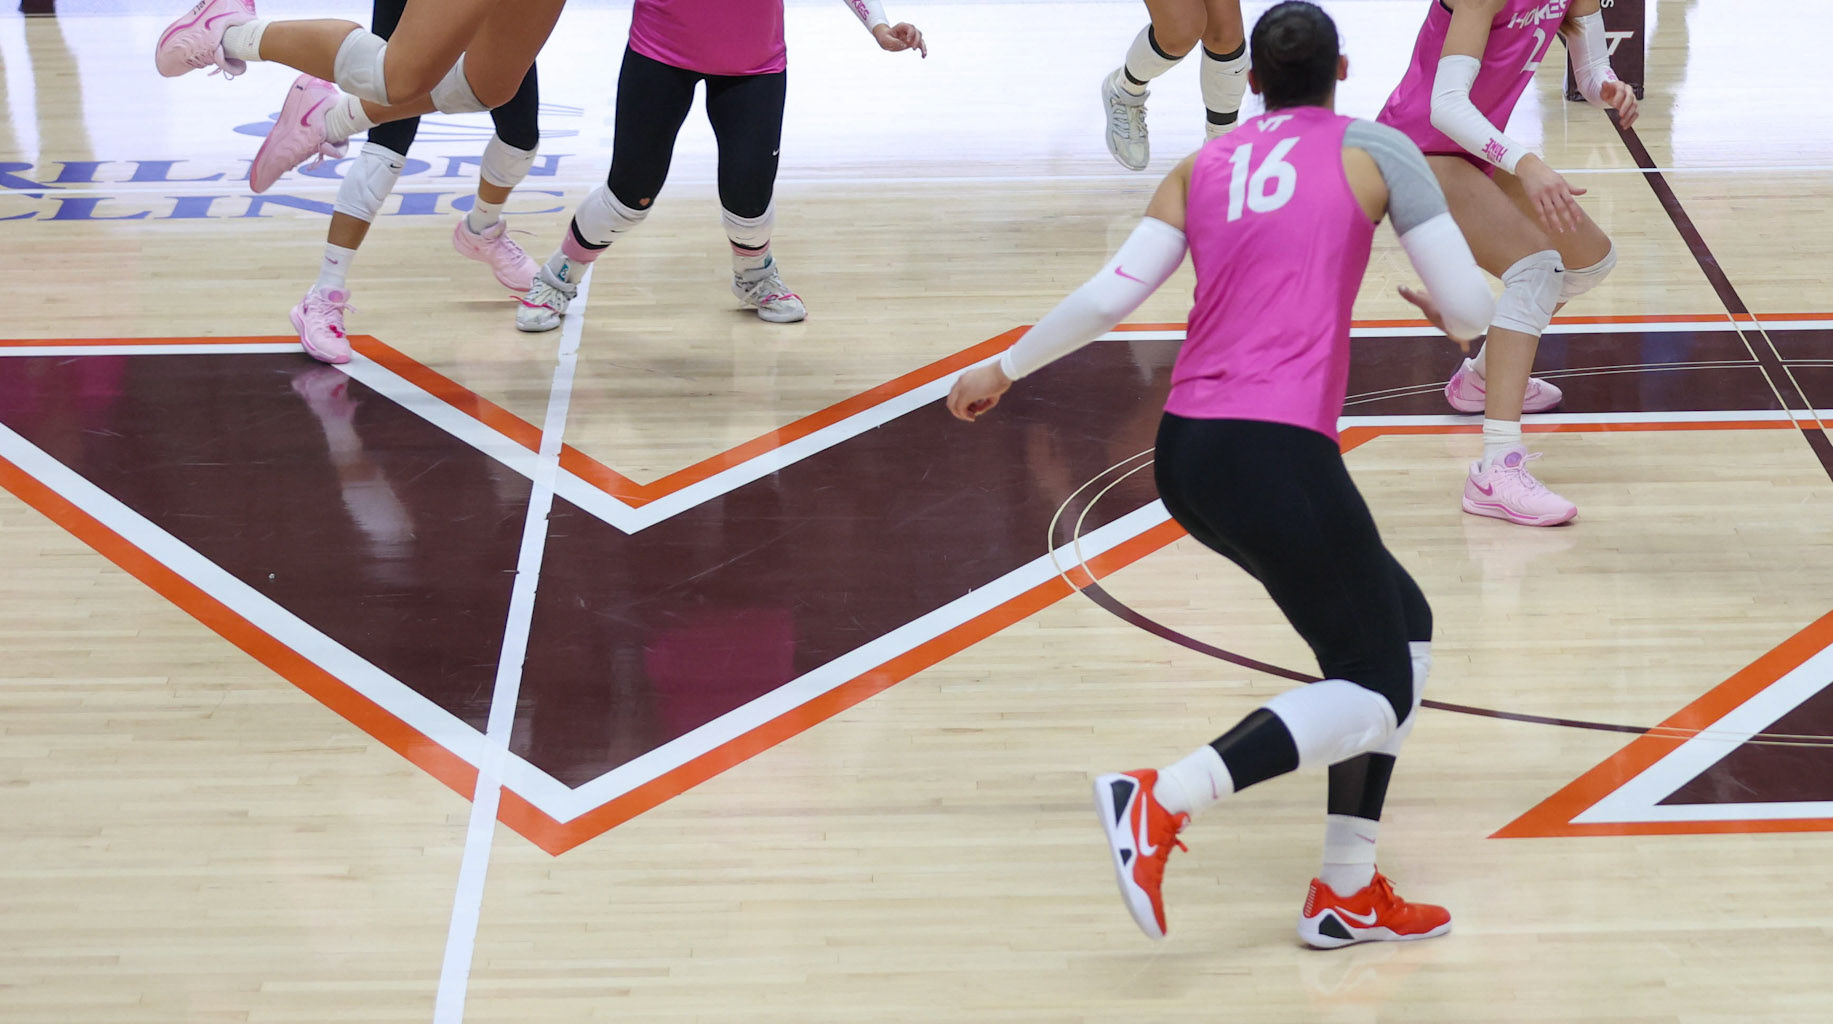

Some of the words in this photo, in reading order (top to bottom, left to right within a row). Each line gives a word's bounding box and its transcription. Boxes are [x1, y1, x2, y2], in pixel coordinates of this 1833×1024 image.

[1520, 27, 1546, 74] 2
[1256, 114, 1295, 133] VT
[1226, 136, 1301, 223] 16
